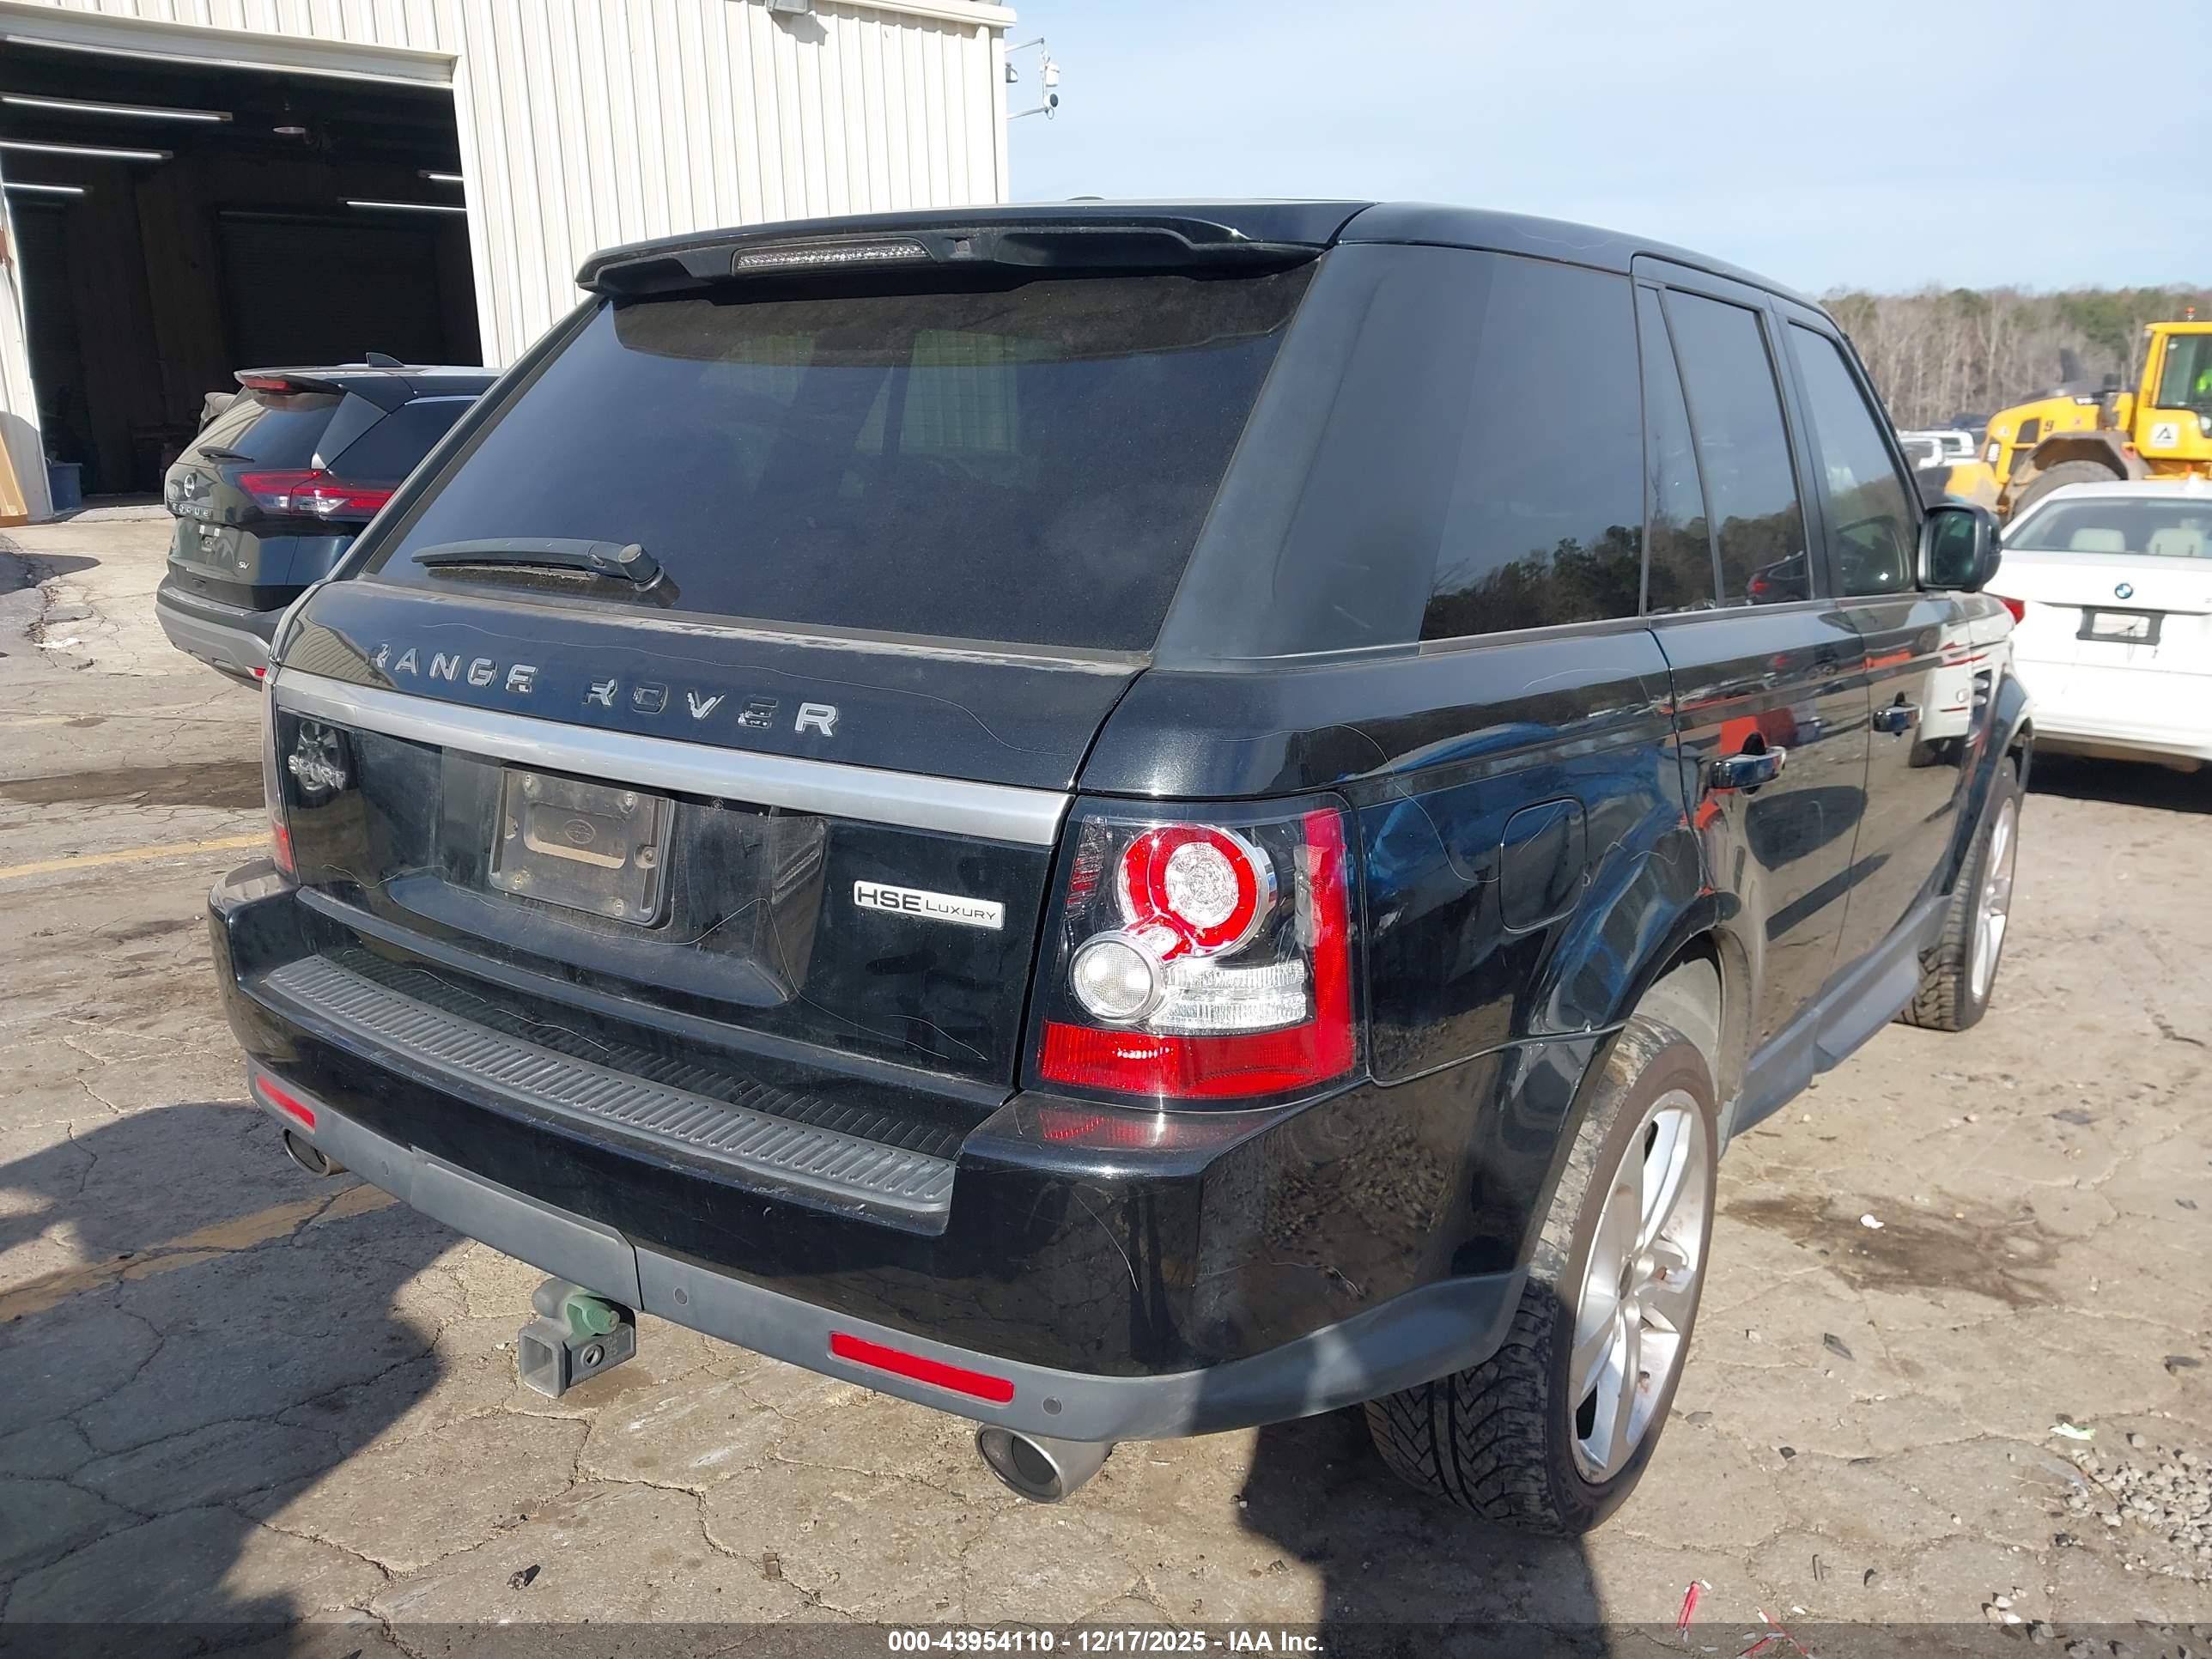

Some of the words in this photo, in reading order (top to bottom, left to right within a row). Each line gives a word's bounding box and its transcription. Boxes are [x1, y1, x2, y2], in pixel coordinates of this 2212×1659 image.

[371, 643, 538, 693] RANGE
[581, 678, 839, 737] ROVER
[858, 886, 921, 913] HSE
[926, 899, 997, 921] LUXURY
